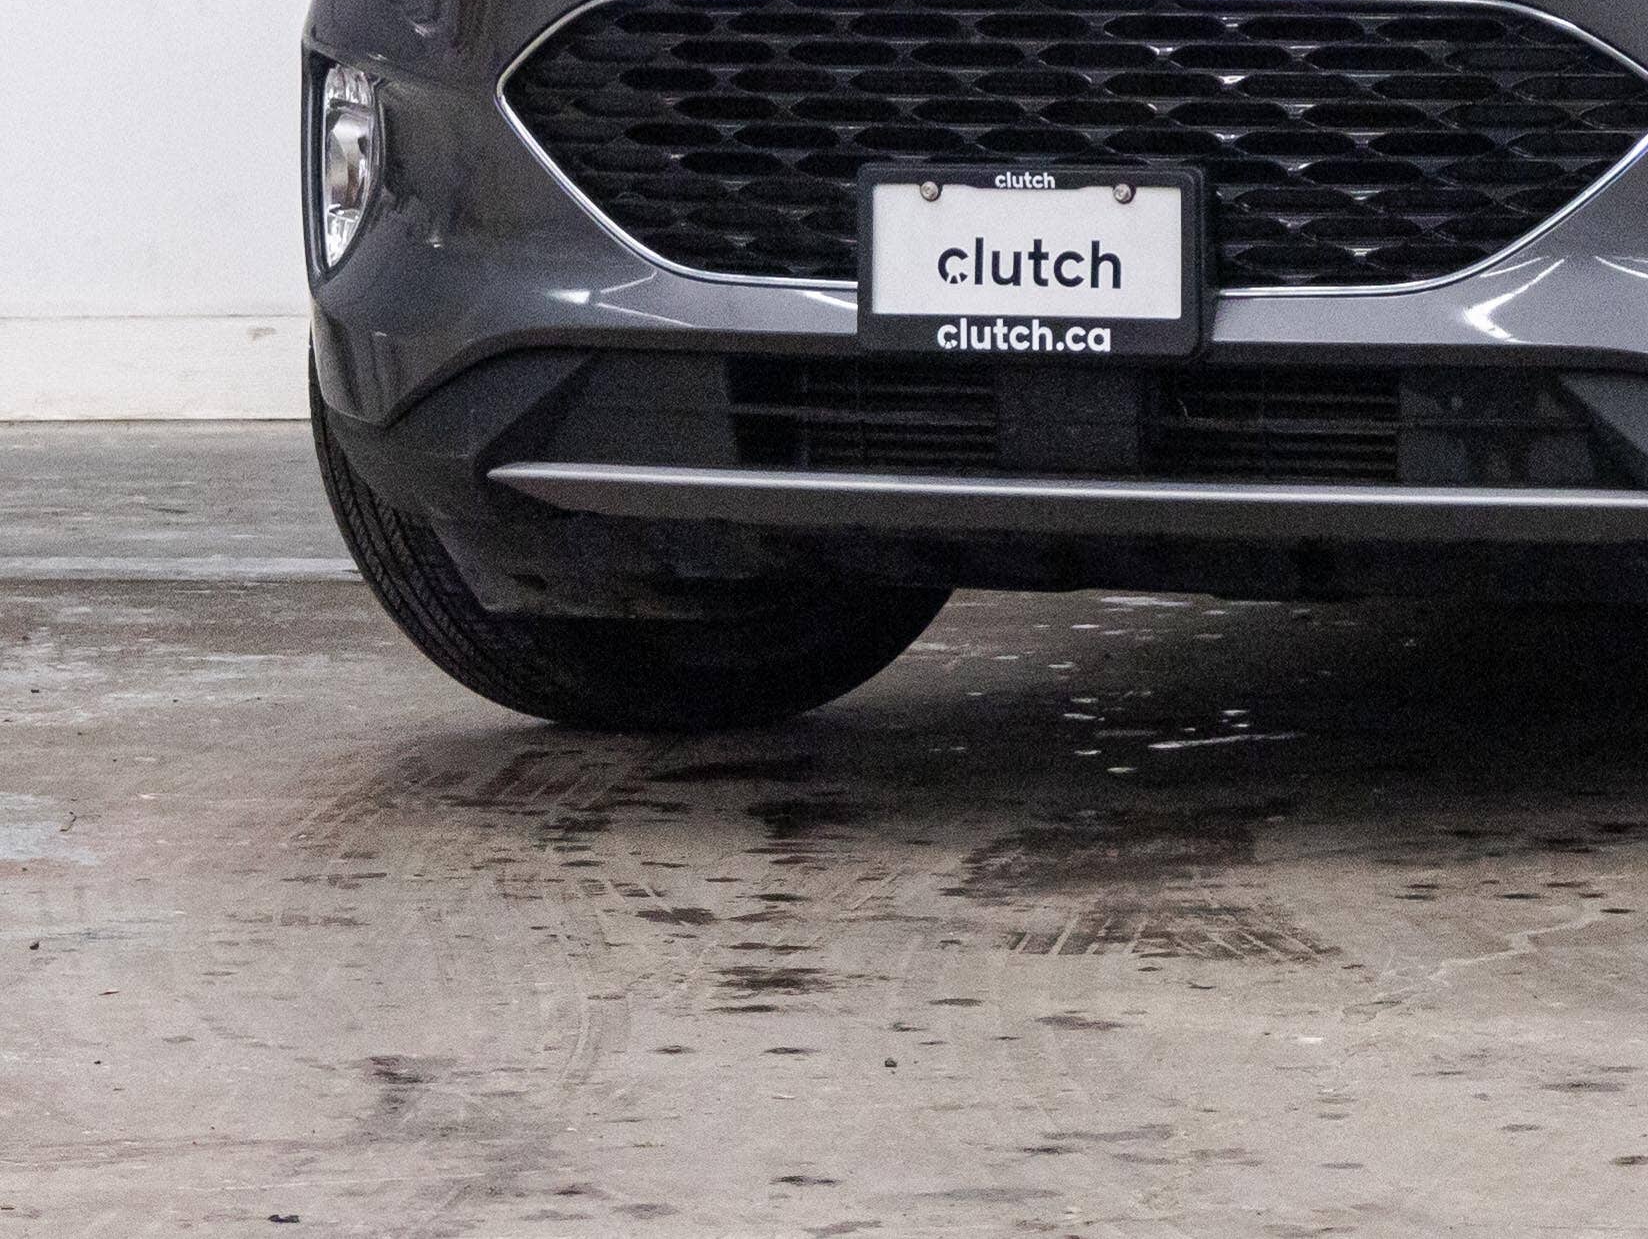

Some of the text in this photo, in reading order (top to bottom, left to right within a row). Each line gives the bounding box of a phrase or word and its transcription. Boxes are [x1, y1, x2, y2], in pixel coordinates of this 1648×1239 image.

[994, 171, 1056, 190] clutch
[937, 237, 1122, 289] clutch
[937, 317, 1112, 353] clutch.ca
